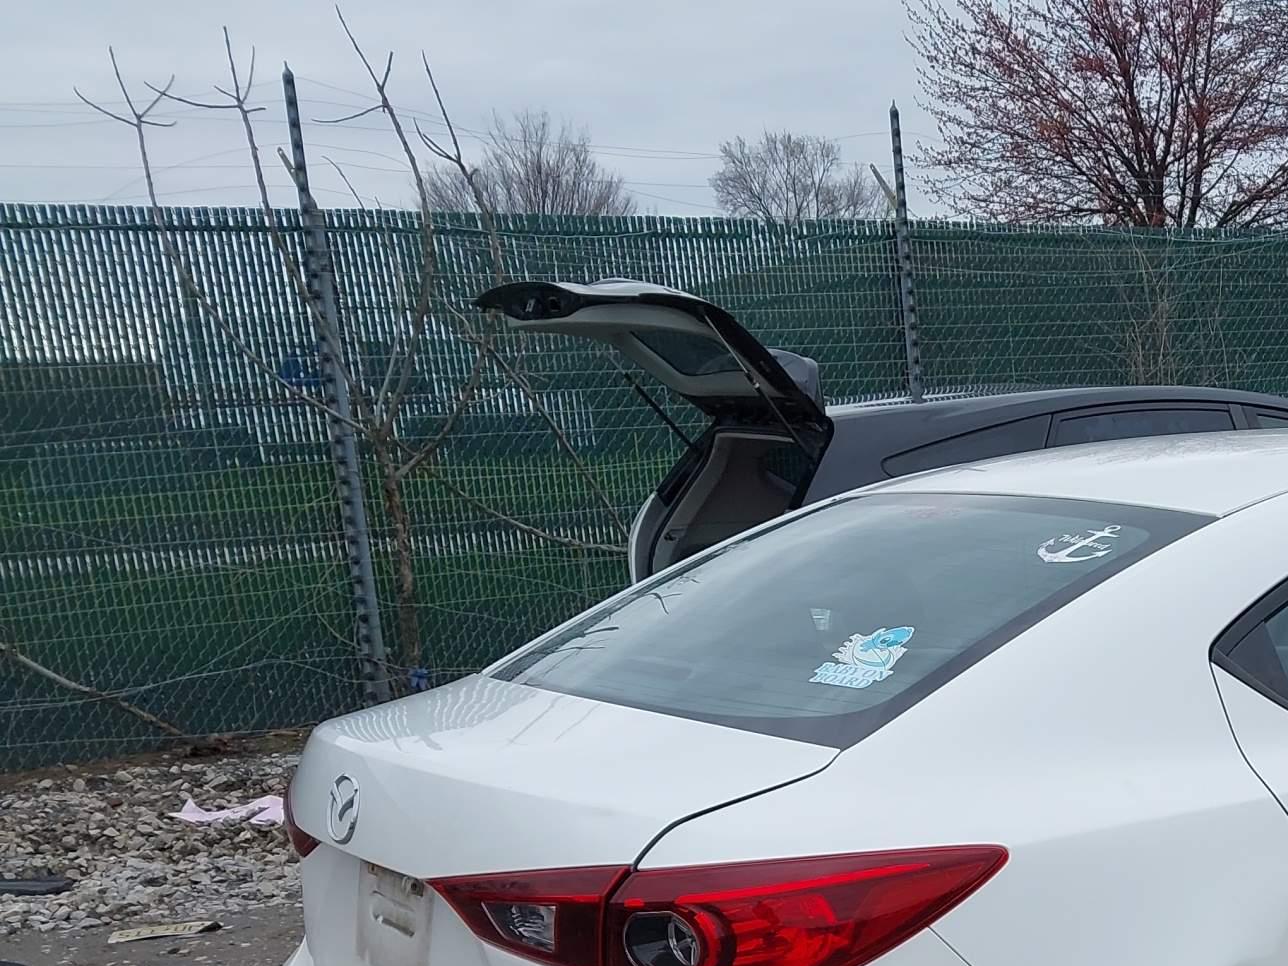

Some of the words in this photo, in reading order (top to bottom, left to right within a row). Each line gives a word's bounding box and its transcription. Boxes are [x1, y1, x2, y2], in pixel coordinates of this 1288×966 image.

[814, 672, 871, 687] BOARD
[818, 663, 858, 677] BABY
[862, 669, 888, 680] ON
